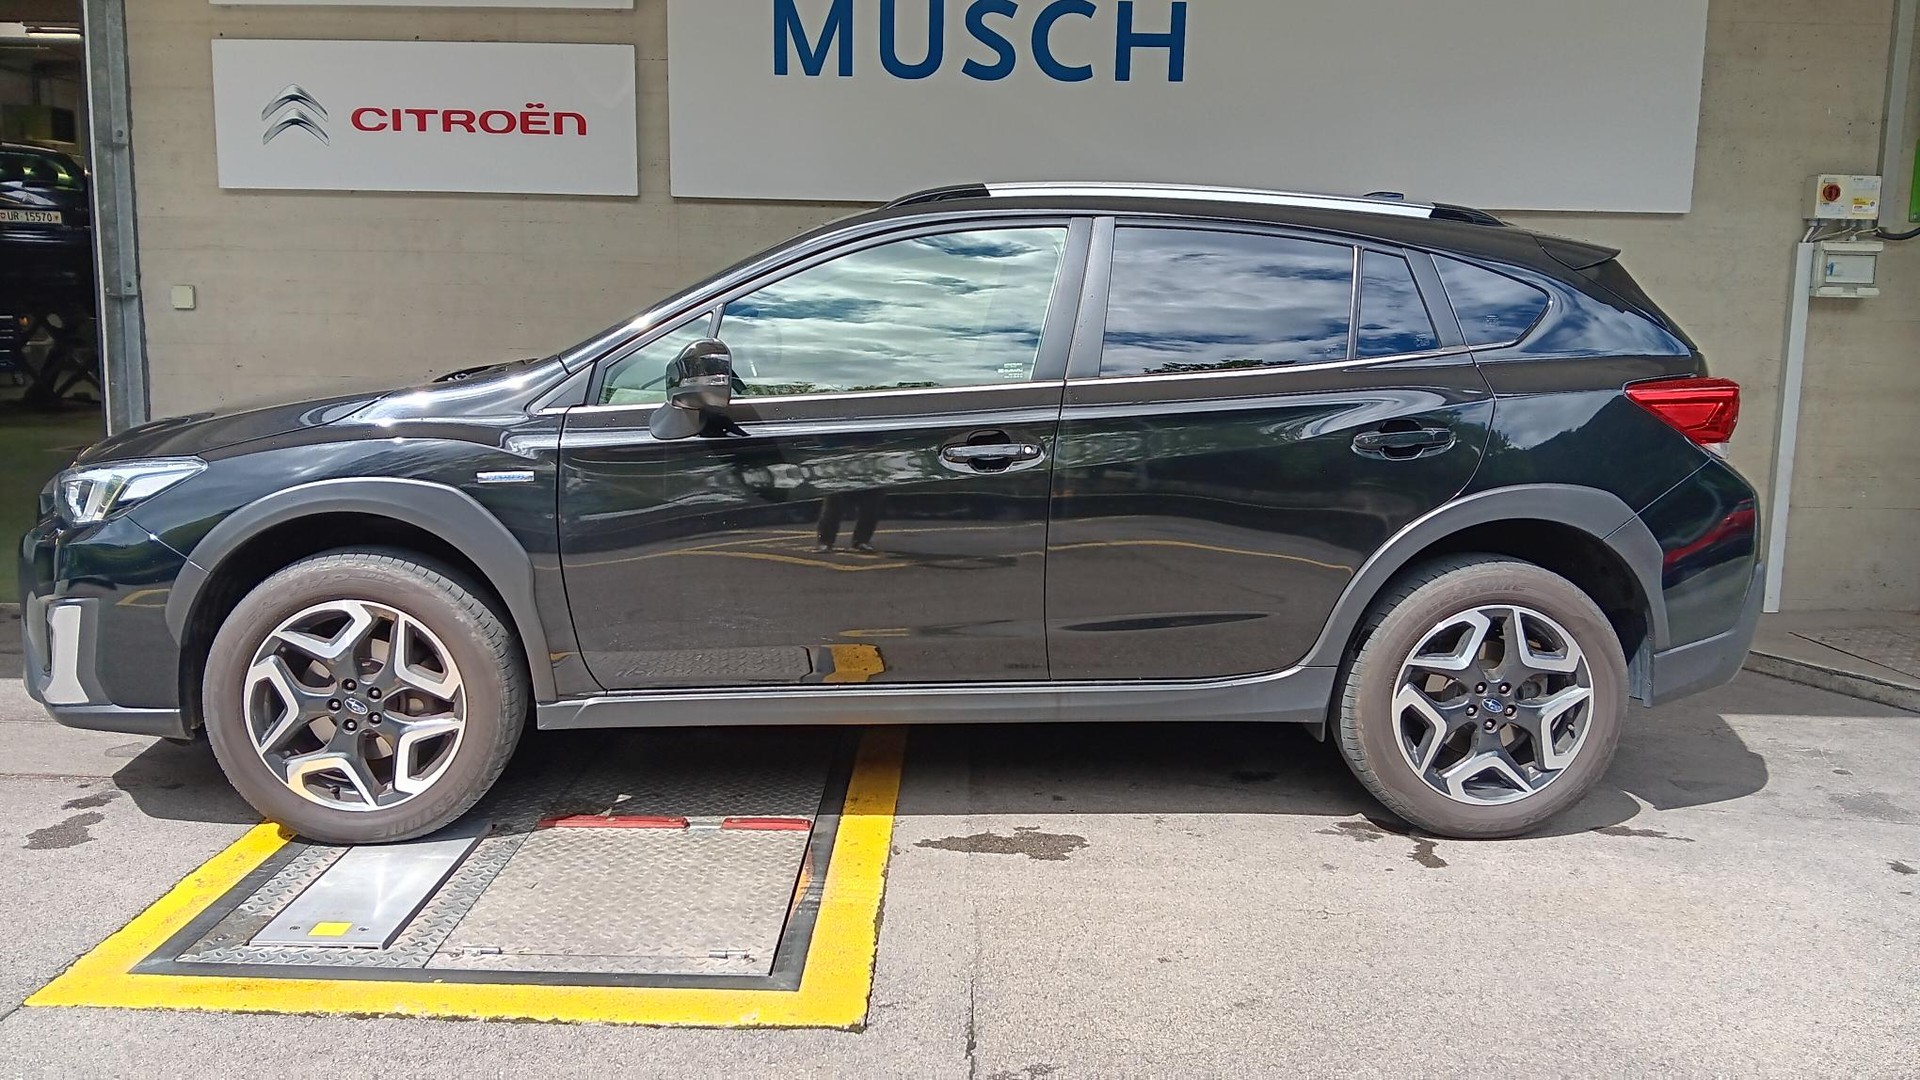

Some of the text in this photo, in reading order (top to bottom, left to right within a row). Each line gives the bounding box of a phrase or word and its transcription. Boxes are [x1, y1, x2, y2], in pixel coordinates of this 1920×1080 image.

[774, 0, 1188, 82] MUSCH
[7, 211, 53, 222] UR 15570
